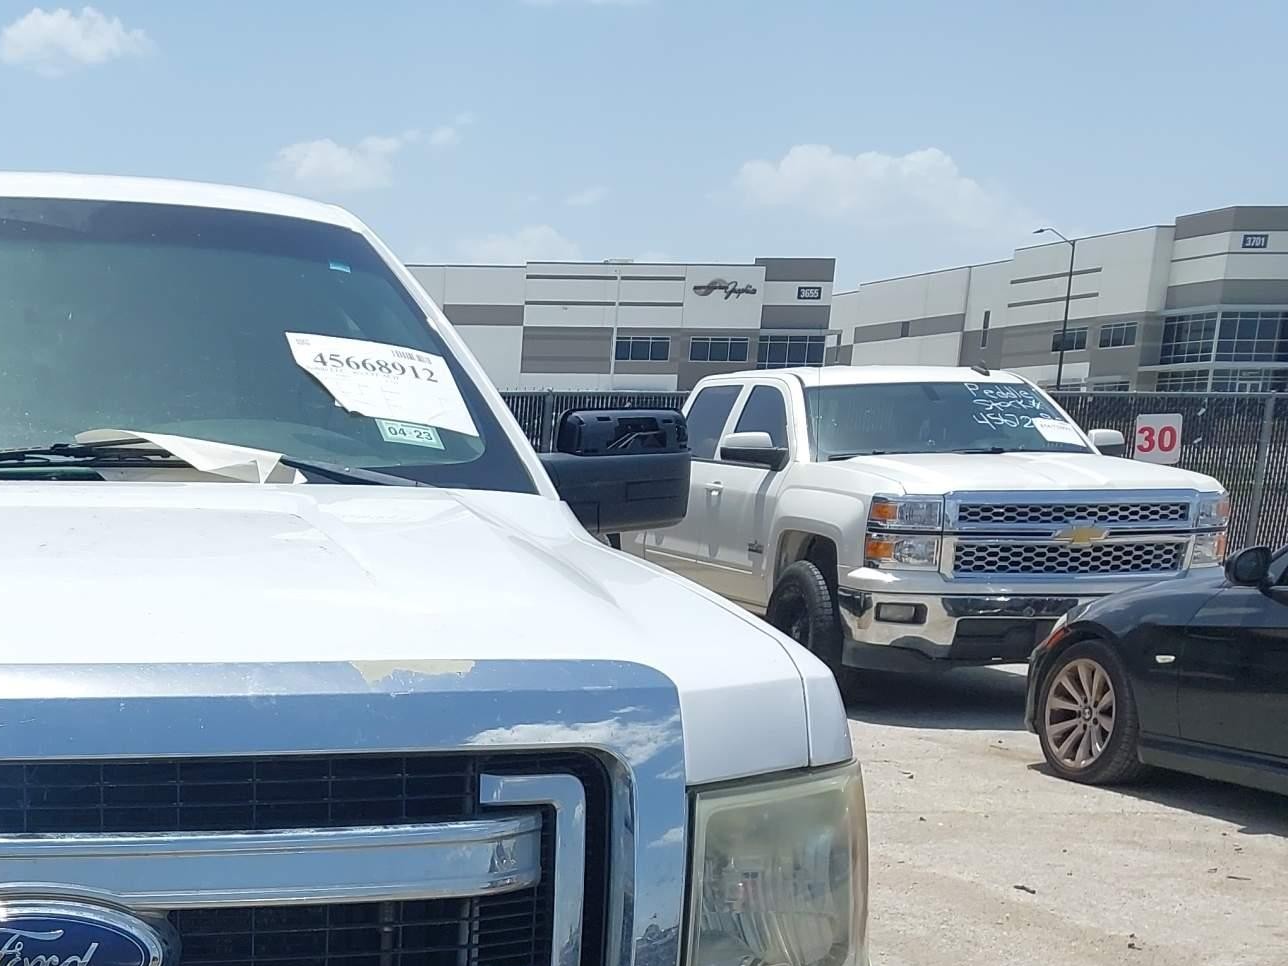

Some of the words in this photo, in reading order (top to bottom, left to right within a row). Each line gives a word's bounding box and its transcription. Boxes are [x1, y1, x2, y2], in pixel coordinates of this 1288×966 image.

[1244, 236, 1265, 247] 3701
[799, 288, 819, 298] 3655
[312, 351, 439, 383] 45668912
[388, 426, 407, 437] 04
[414, 429, 433, 441] 23
[1136, 425, 1177, 453] 30
